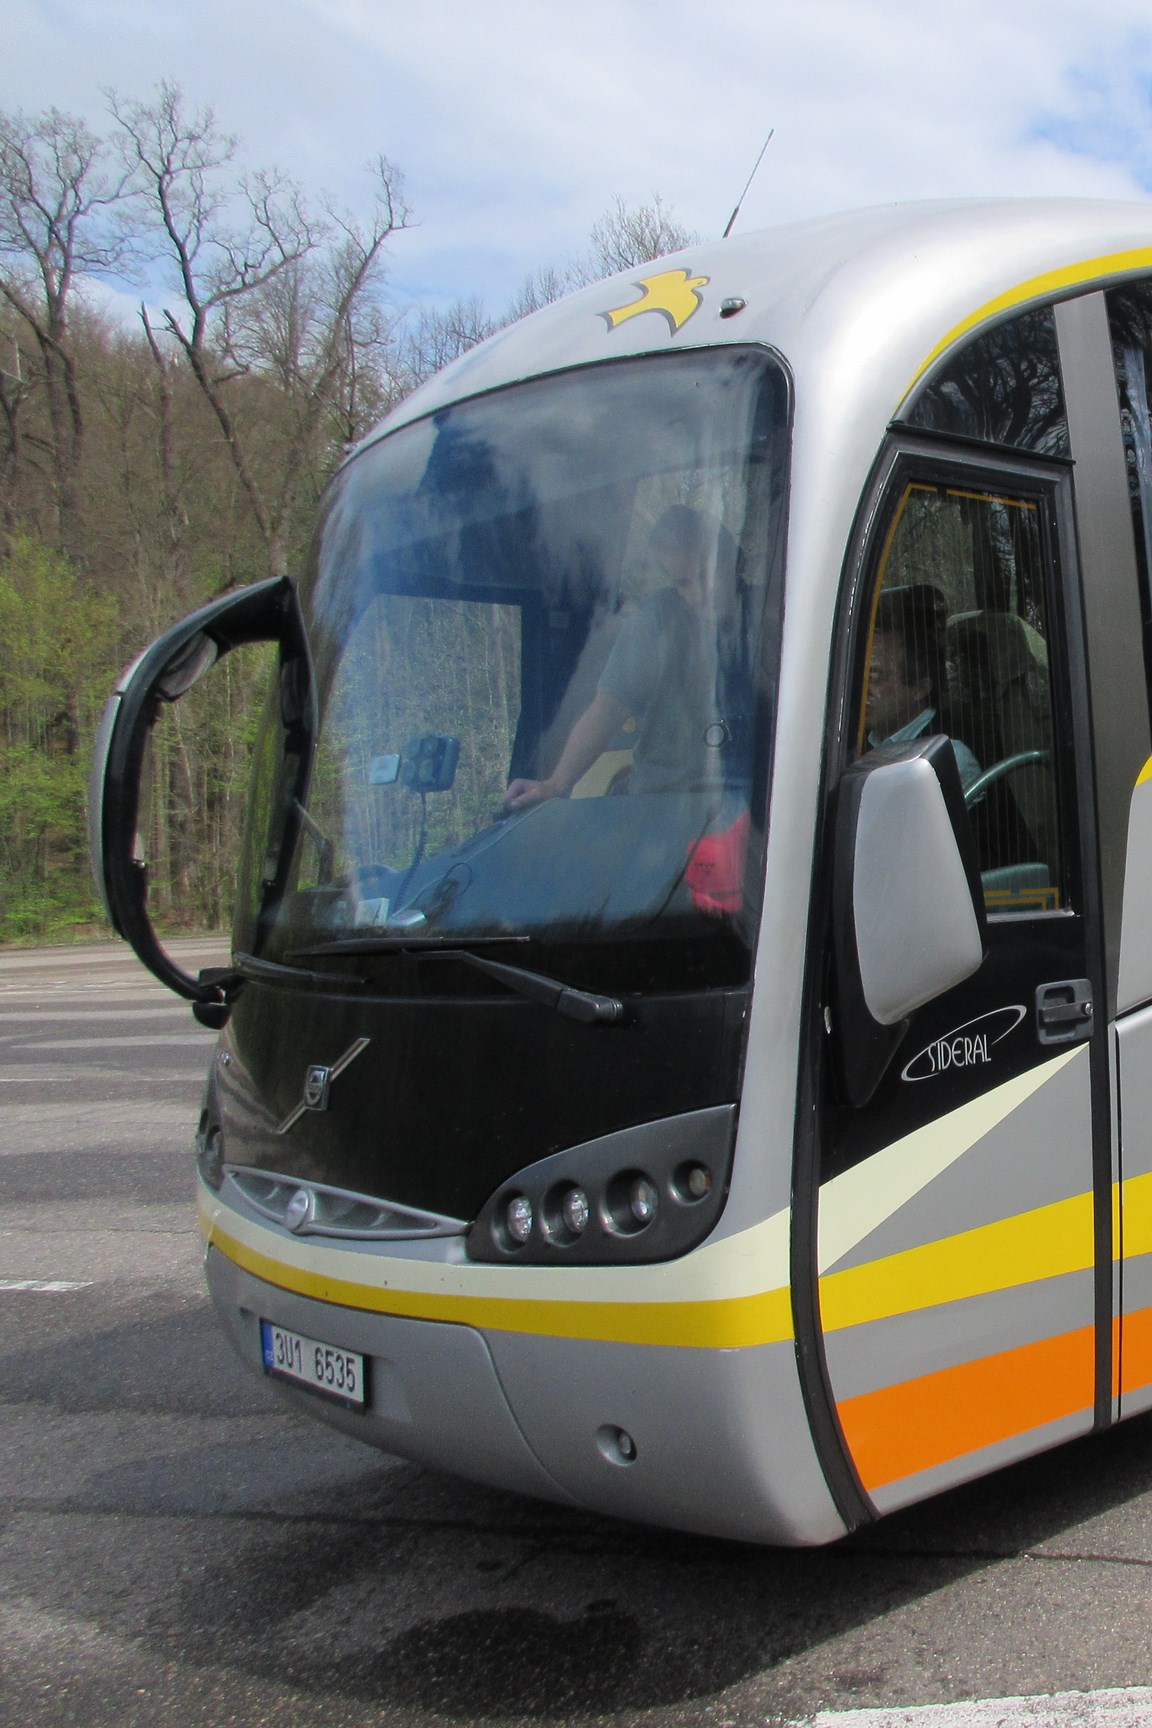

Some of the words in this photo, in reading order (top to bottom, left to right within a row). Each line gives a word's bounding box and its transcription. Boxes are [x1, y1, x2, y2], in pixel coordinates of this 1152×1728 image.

[928, 1034, 992, 1072] SIDERAL
[275, 1333, 303, 1374] 3U1
[315, 1346, 356, 1393] 6535
